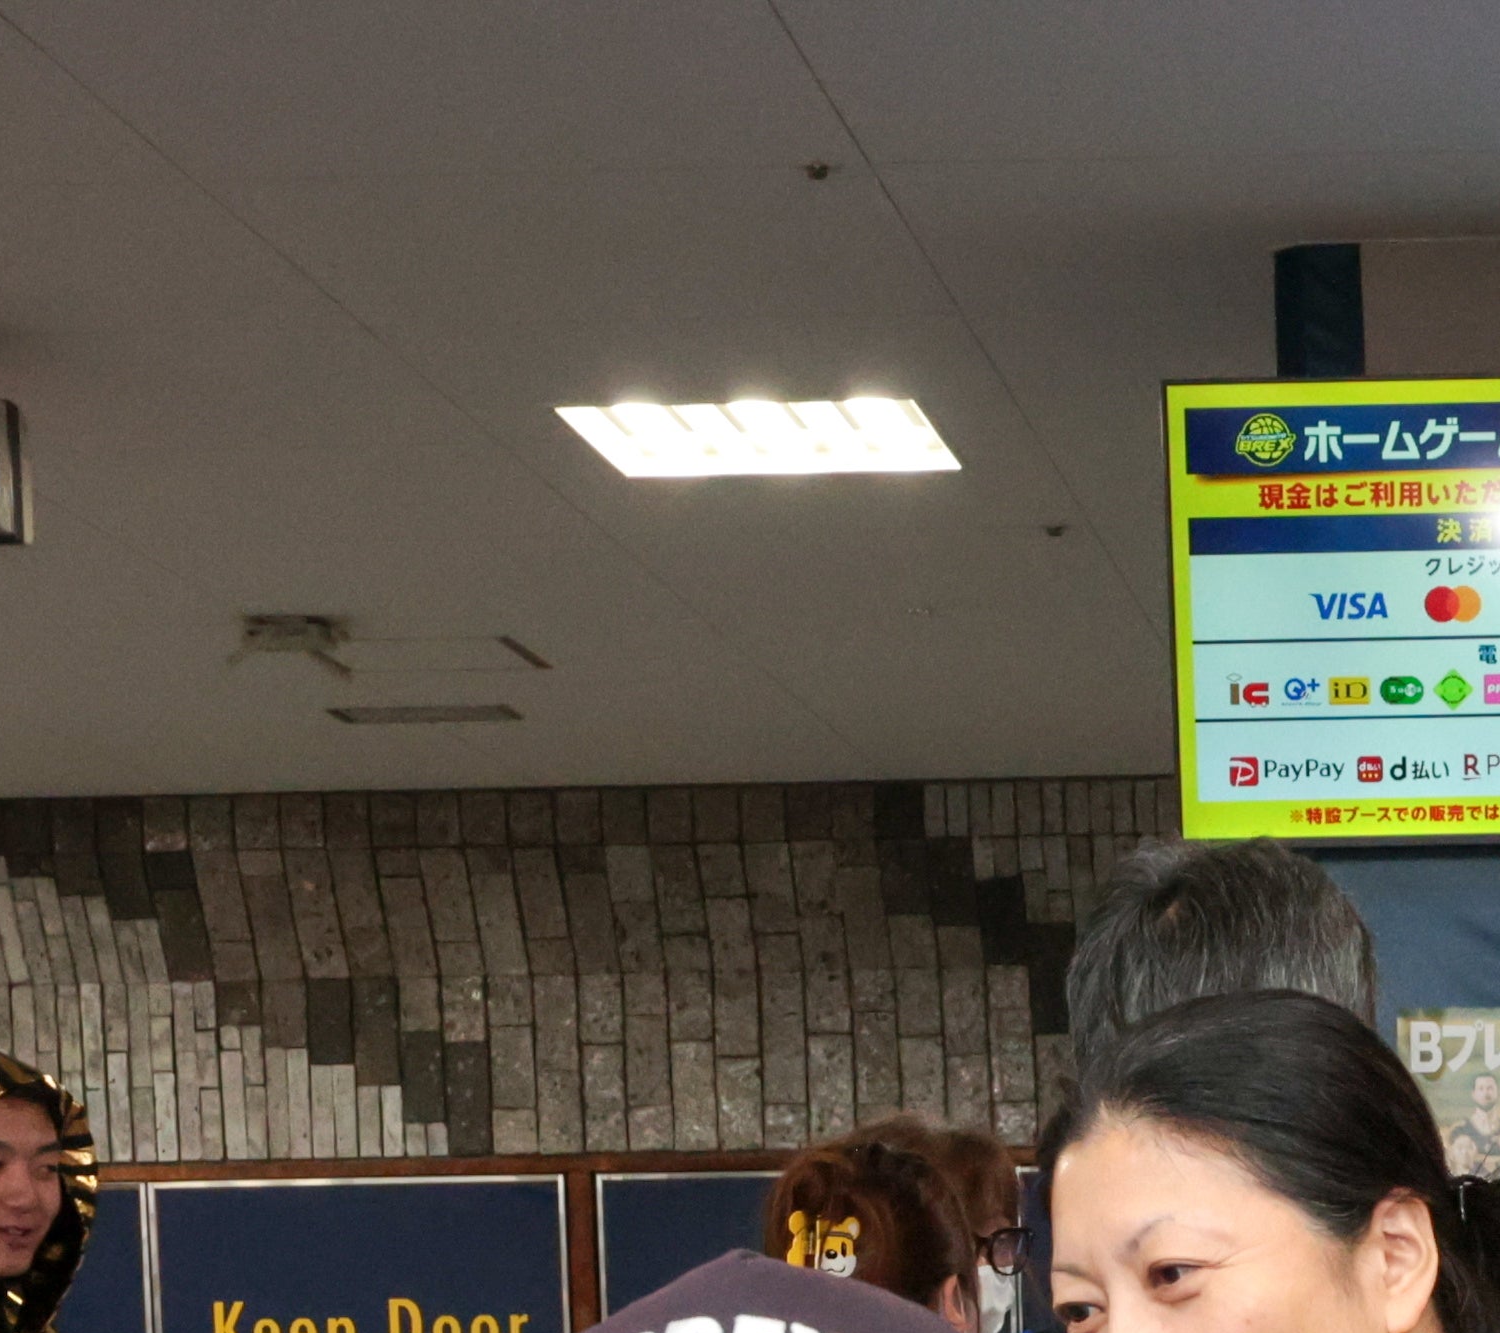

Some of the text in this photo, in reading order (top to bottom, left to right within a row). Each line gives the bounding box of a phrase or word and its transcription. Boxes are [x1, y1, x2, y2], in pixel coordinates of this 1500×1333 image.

[1239, 437, 1294, 451] BREX
[1309, 592, 1388, 620] VISA
[1333, 682, 1368, 699] iD
[1264, 759, 1345, 782] PayPay
[1389, 756, 1450, 781] d払い
